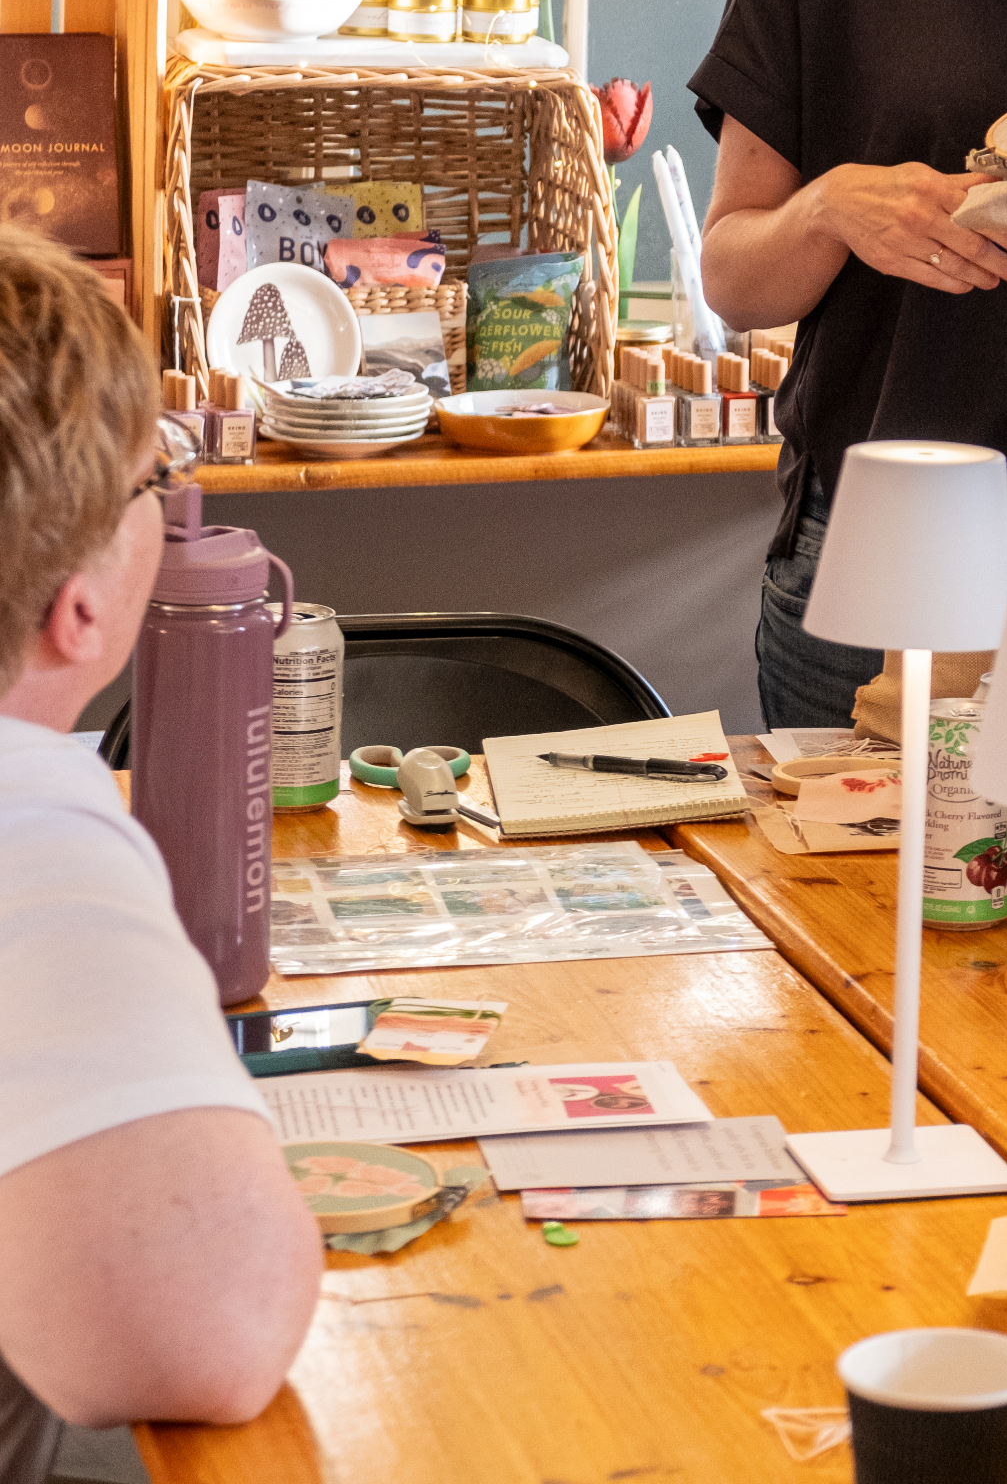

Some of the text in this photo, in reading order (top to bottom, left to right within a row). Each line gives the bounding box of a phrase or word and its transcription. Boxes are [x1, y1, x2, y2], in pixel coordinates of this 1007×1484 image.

[0, 142, 105, 153] MOON JOURNAL
[492, 307, 532, 320] SOUR
[479, 323, 562, 337] DERFLOWER
[491, 340, 523, 353] FISH
[273, 654, 336, 665] Nutrition Facts
[927, 748, 973, 771] Nature
[926, 768, 969, 785] Promi
[247, 706, 270, 914] lululemon
[934, 810, 965, 822] Cherry
[968, 809, 1002, 821] Flavored
[924, 820, 950, 832] rkling
